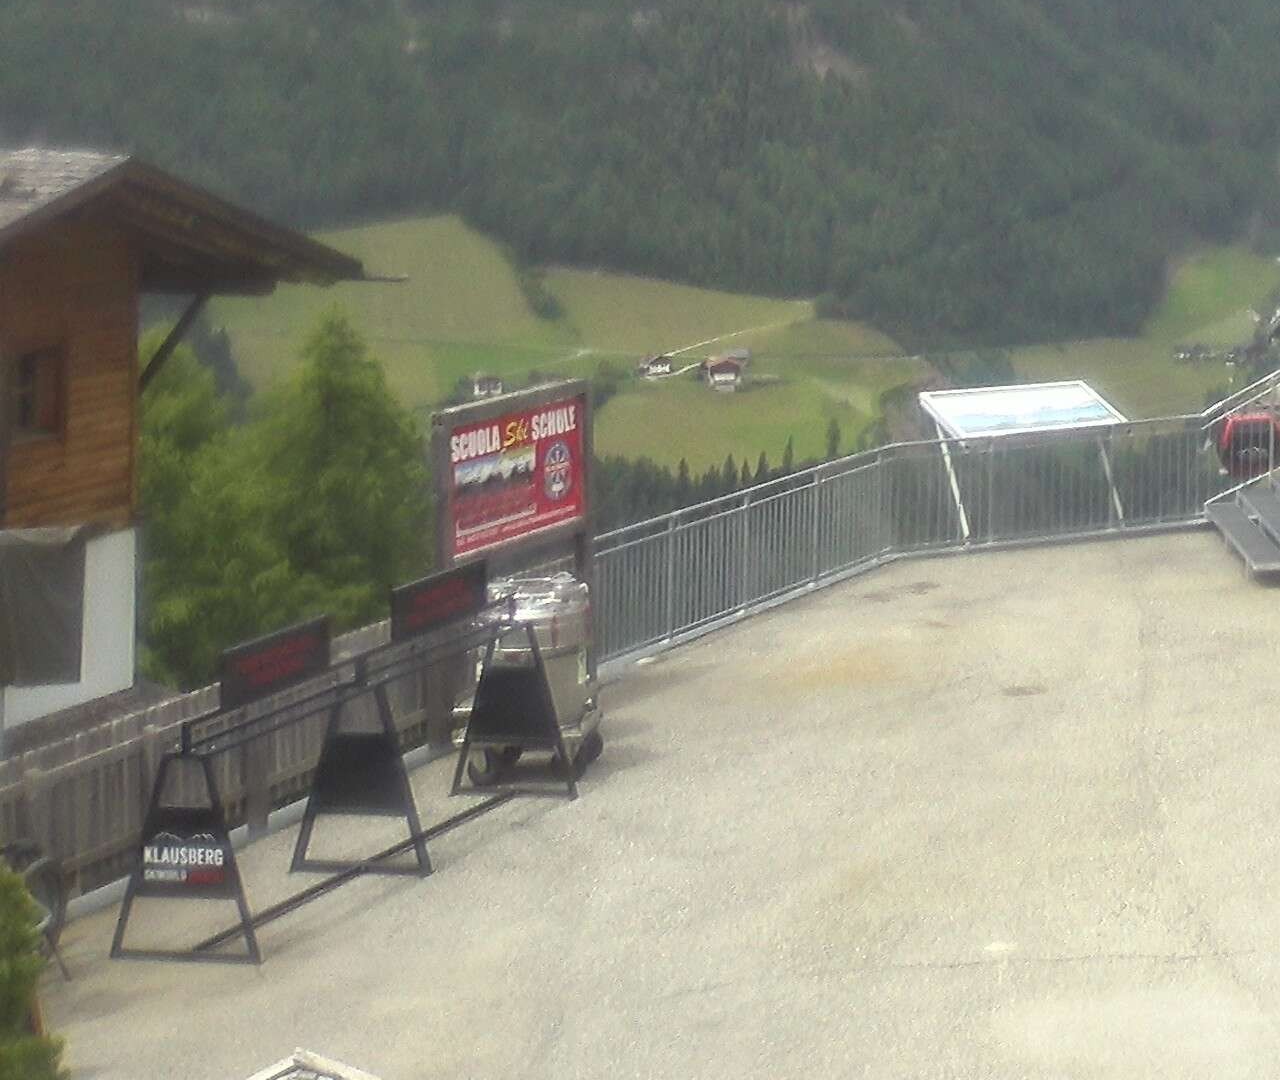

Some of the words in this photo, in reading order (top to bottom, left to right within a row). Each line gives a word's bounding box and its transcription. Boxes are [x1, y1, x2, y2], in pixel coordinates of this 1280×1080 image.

[451, 425, 501, 463] SCUOLA
[503, 418, 529, 447] Ski
[531, 405, 577, 440] SCHULE
[143, 845, 224, 866] KLAUSBERG
